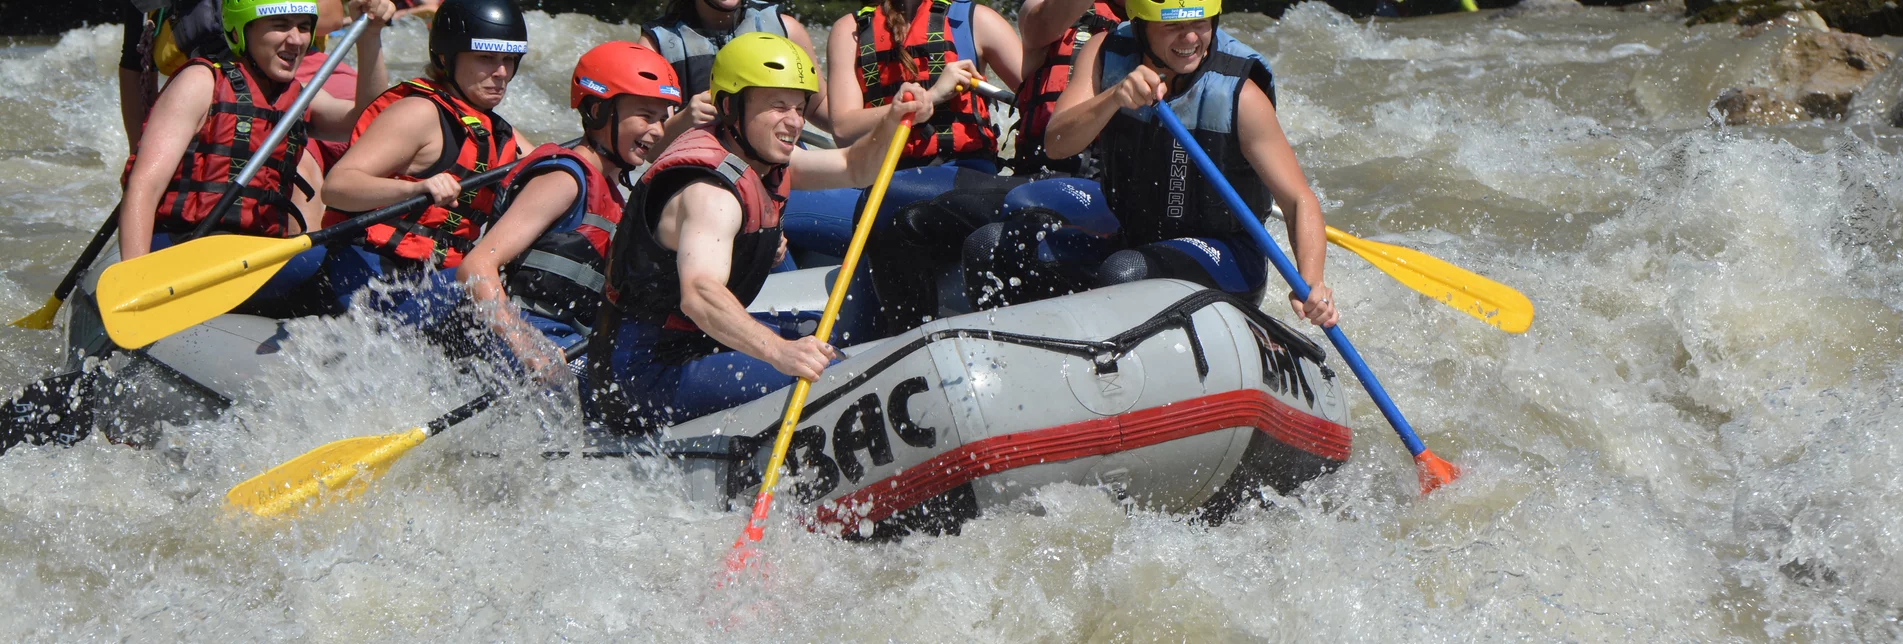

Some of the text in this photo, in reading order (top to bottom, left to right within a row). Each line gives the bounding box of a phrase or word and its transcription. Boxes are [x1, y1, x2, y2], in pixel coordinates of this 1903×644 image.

[1178, 9, 1203, 18] bac
[588, 81, 606, 94] bac
[784, 376, 937, 505] BAC
